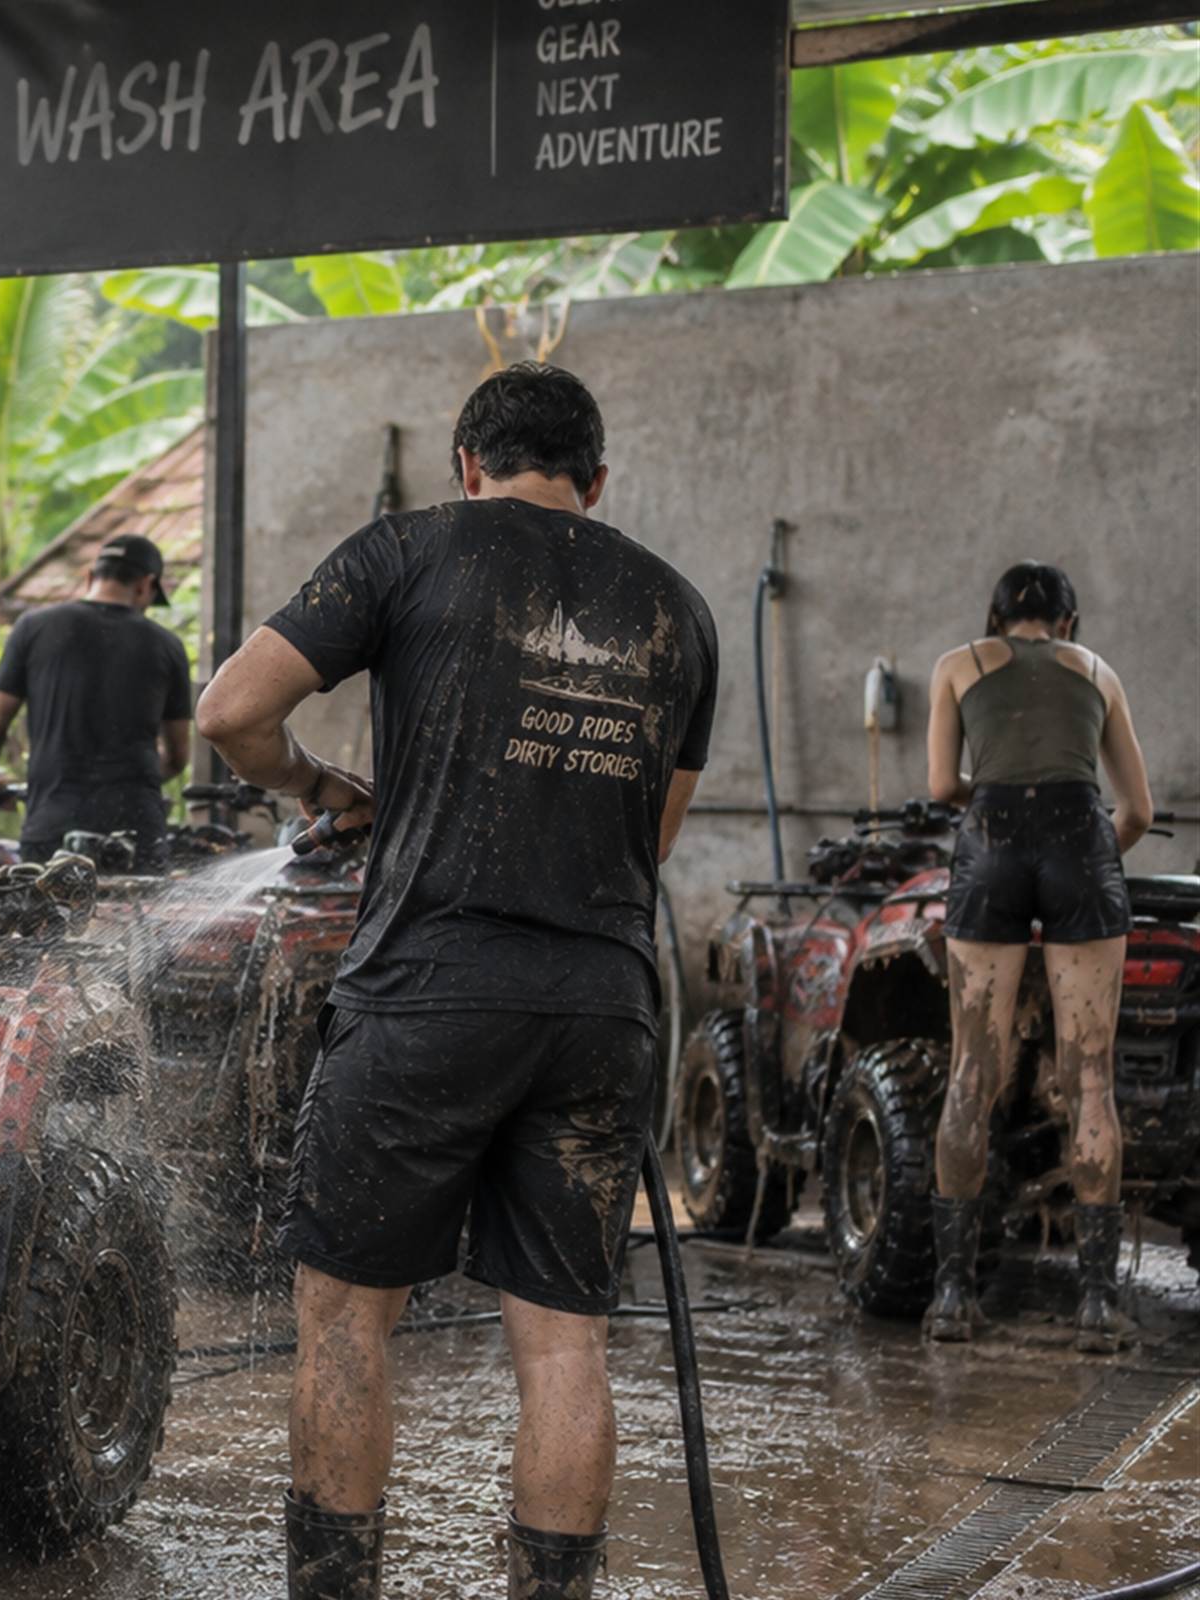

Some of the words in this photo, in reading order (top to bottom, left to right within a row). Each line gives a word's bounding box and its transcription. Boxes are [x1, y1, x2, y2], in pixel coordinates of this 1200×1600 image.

[536, 19, 621, 64] GEAR
[15, 48, 211, 166] WASH
[238, 23, 440, 145] AREA
[536, 73, 620, 117] NEXT
[534, 117, 724, 171] ADVENTURE
[521, 705, 575, 735] GOOD
[579, 716, 637, 743] RIDES
[504, 738, 561, 769] DIRTY
[563, 749, 643, 781] STORIES
